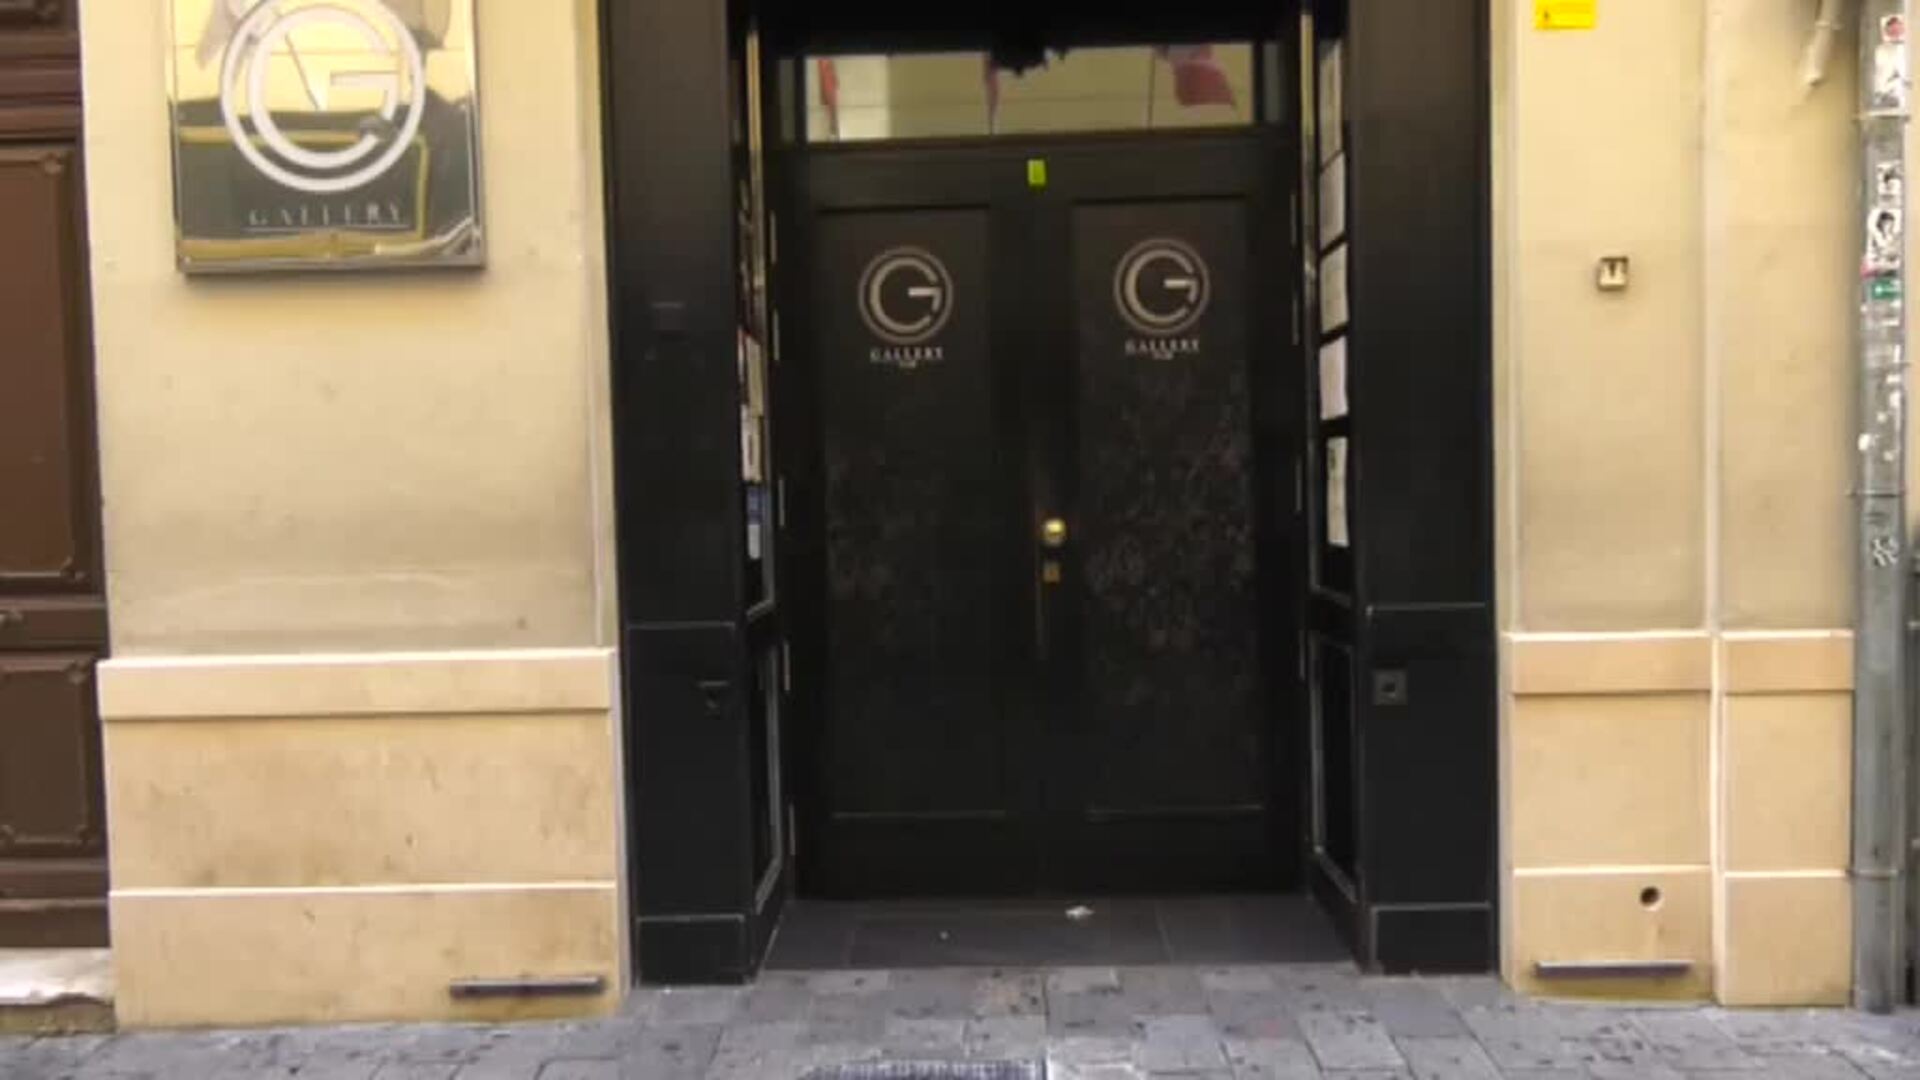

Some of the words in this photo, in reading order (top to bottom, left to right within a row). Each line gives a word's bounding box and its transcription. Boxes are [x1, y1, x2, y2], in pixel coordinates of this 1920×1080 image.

[248, 203, 402, 226] GALLERY
[869, 346, 944, 362] GALLERY
[1125, 339, 1200, 354] GALLERY
